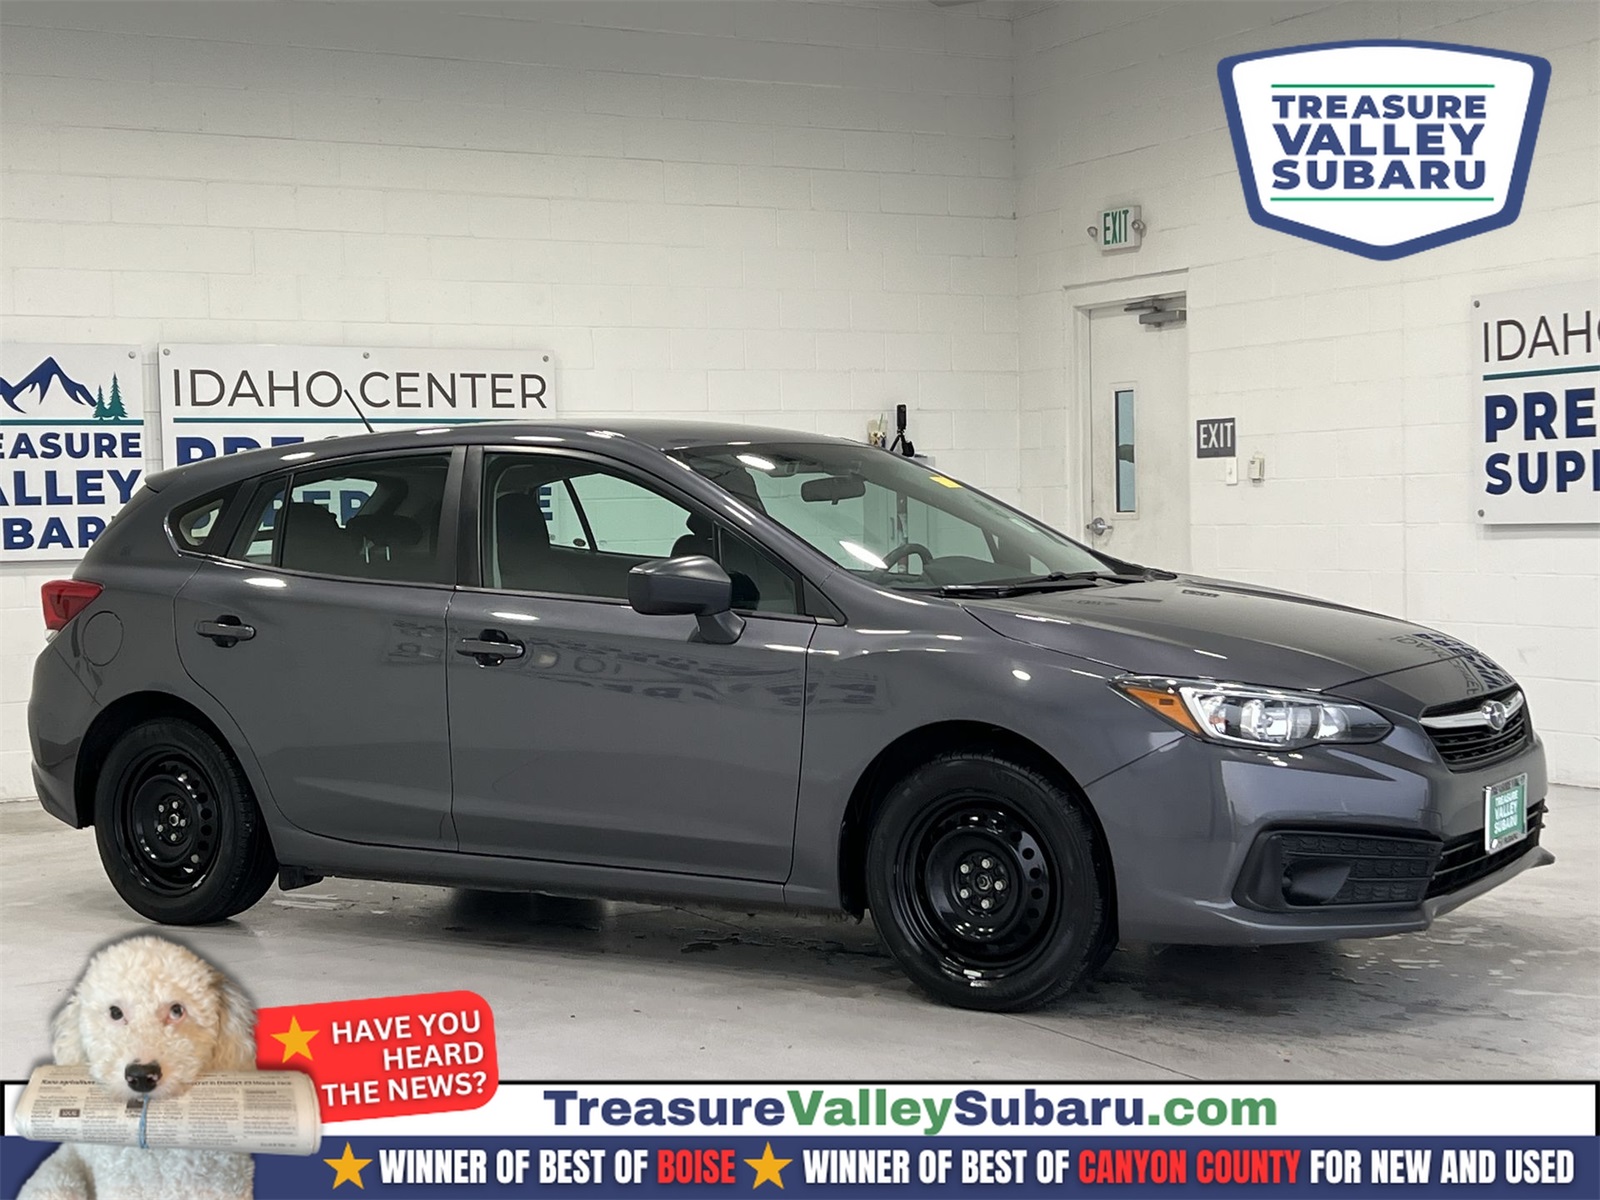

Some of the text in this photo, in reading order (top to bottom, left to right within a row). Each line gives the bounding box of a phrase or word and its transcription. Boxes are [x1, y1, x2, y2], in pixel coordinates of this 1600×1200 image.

[1103, 209, 1130, 246] EXIT
[1483, 310, 1600, 363] IDAH
[173, 369, 548, 410] IDAHO CENTER
[1484, 387, 1597, 443] PRE
[0, 431, 142, 459] ASURE
[1199, 421, 1235, 450] EXIT
